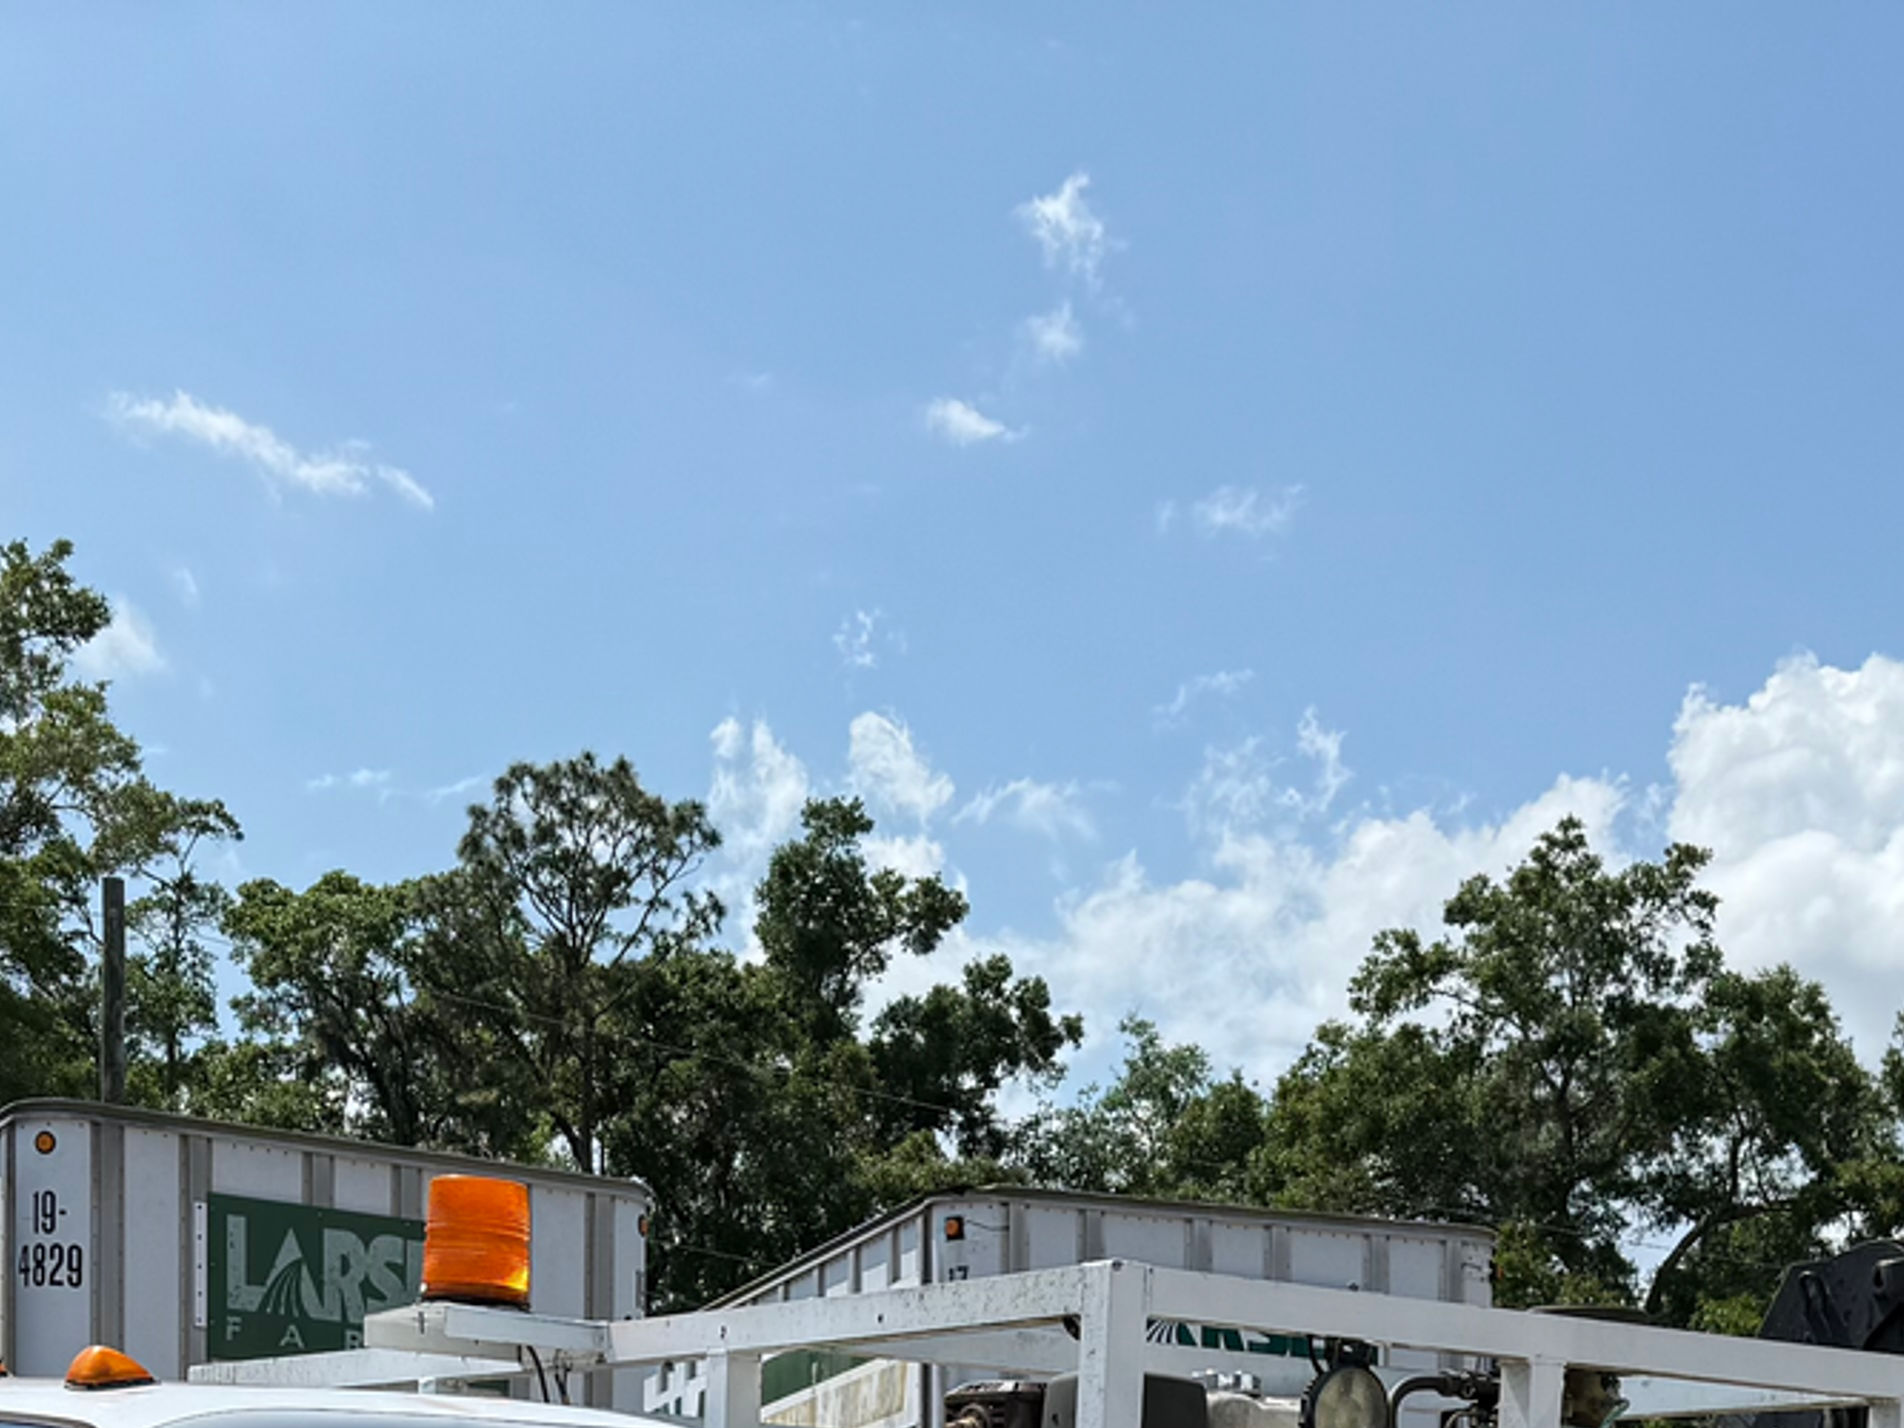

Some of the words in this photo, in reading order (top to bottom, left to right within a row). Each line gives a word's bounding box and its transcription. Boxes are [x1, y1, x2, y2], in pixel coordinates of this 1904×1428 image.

[33, 1190, 67, 1234] 19-
[18, 1243, 83, 1288] 4829
[226, 1214, 424, 1324] LARS
